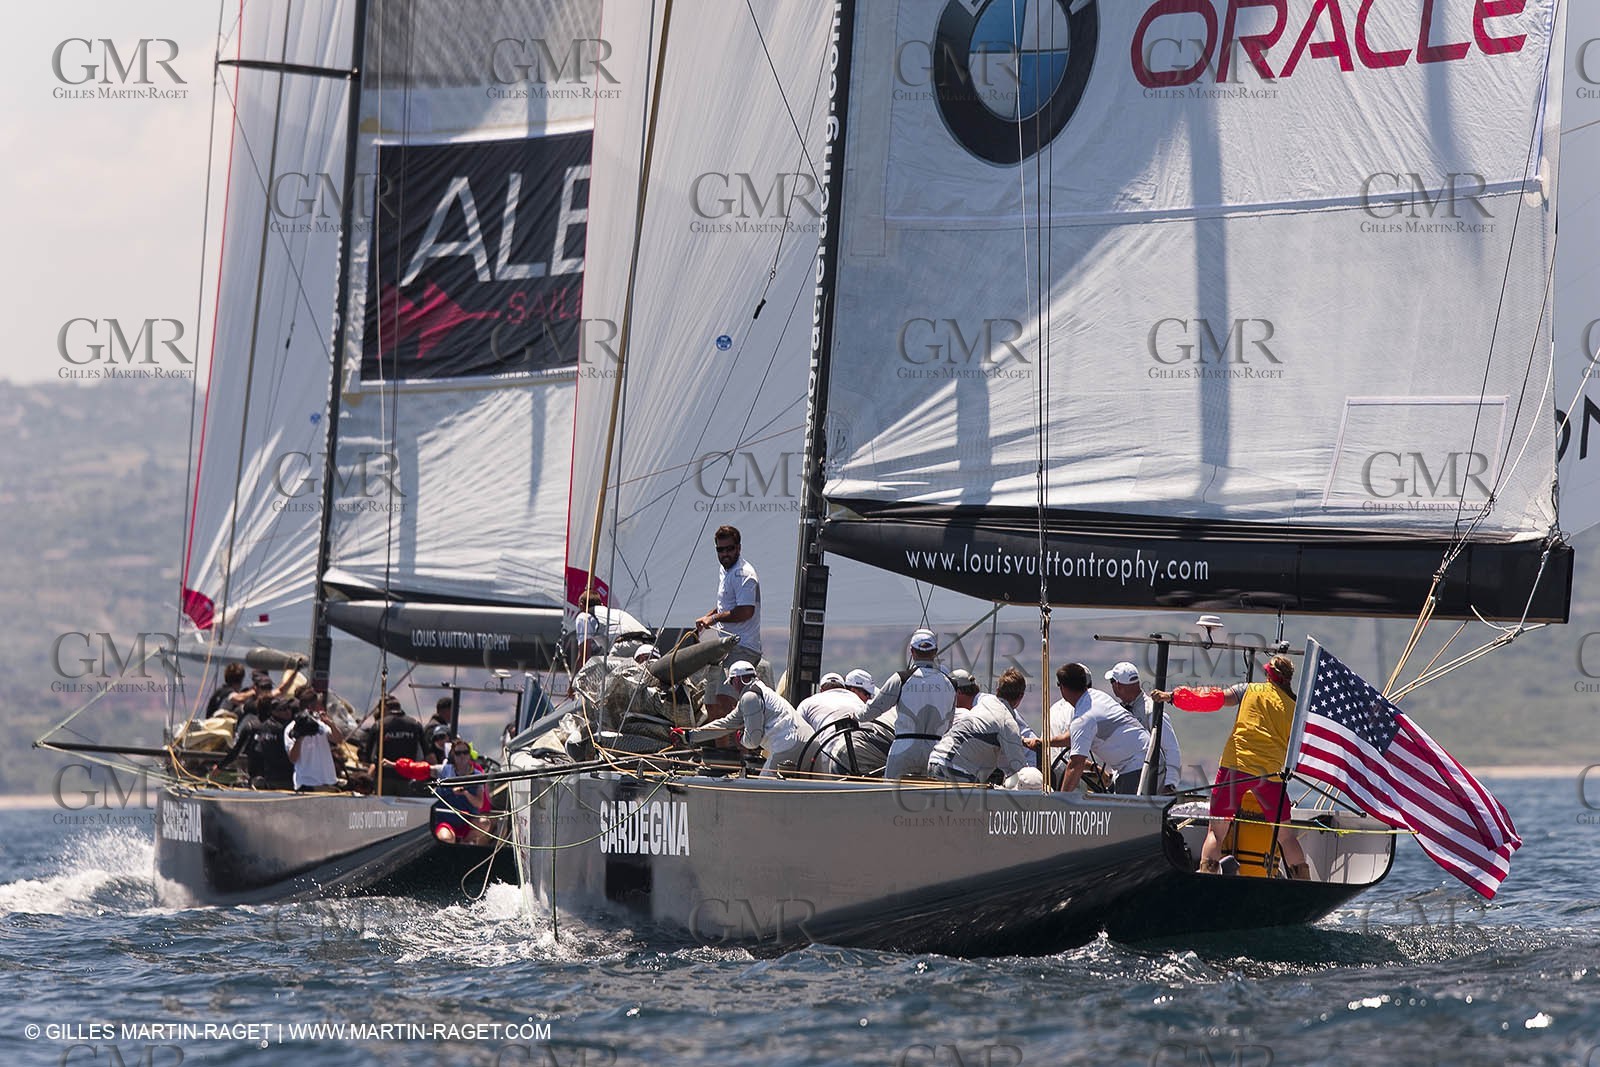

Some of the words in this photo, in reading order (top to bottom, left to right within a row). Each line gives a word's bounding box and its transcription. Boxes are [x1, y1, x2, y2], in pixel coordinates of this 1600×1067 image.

[1131, 0, 1528, 89] ORACLE
[412, 629, 436, 647] LOUIS
[438, 631, 475, 649] VUITTON
[477, 632, 511, 651] TROPHY
[600, 800, 690, 856] SARDEGNA
[988, 811, 1018, 835] LOUIS
[1021, 811, 1066, 835] VUITTON
[1069, 811, 1111, 836] TROPHY
